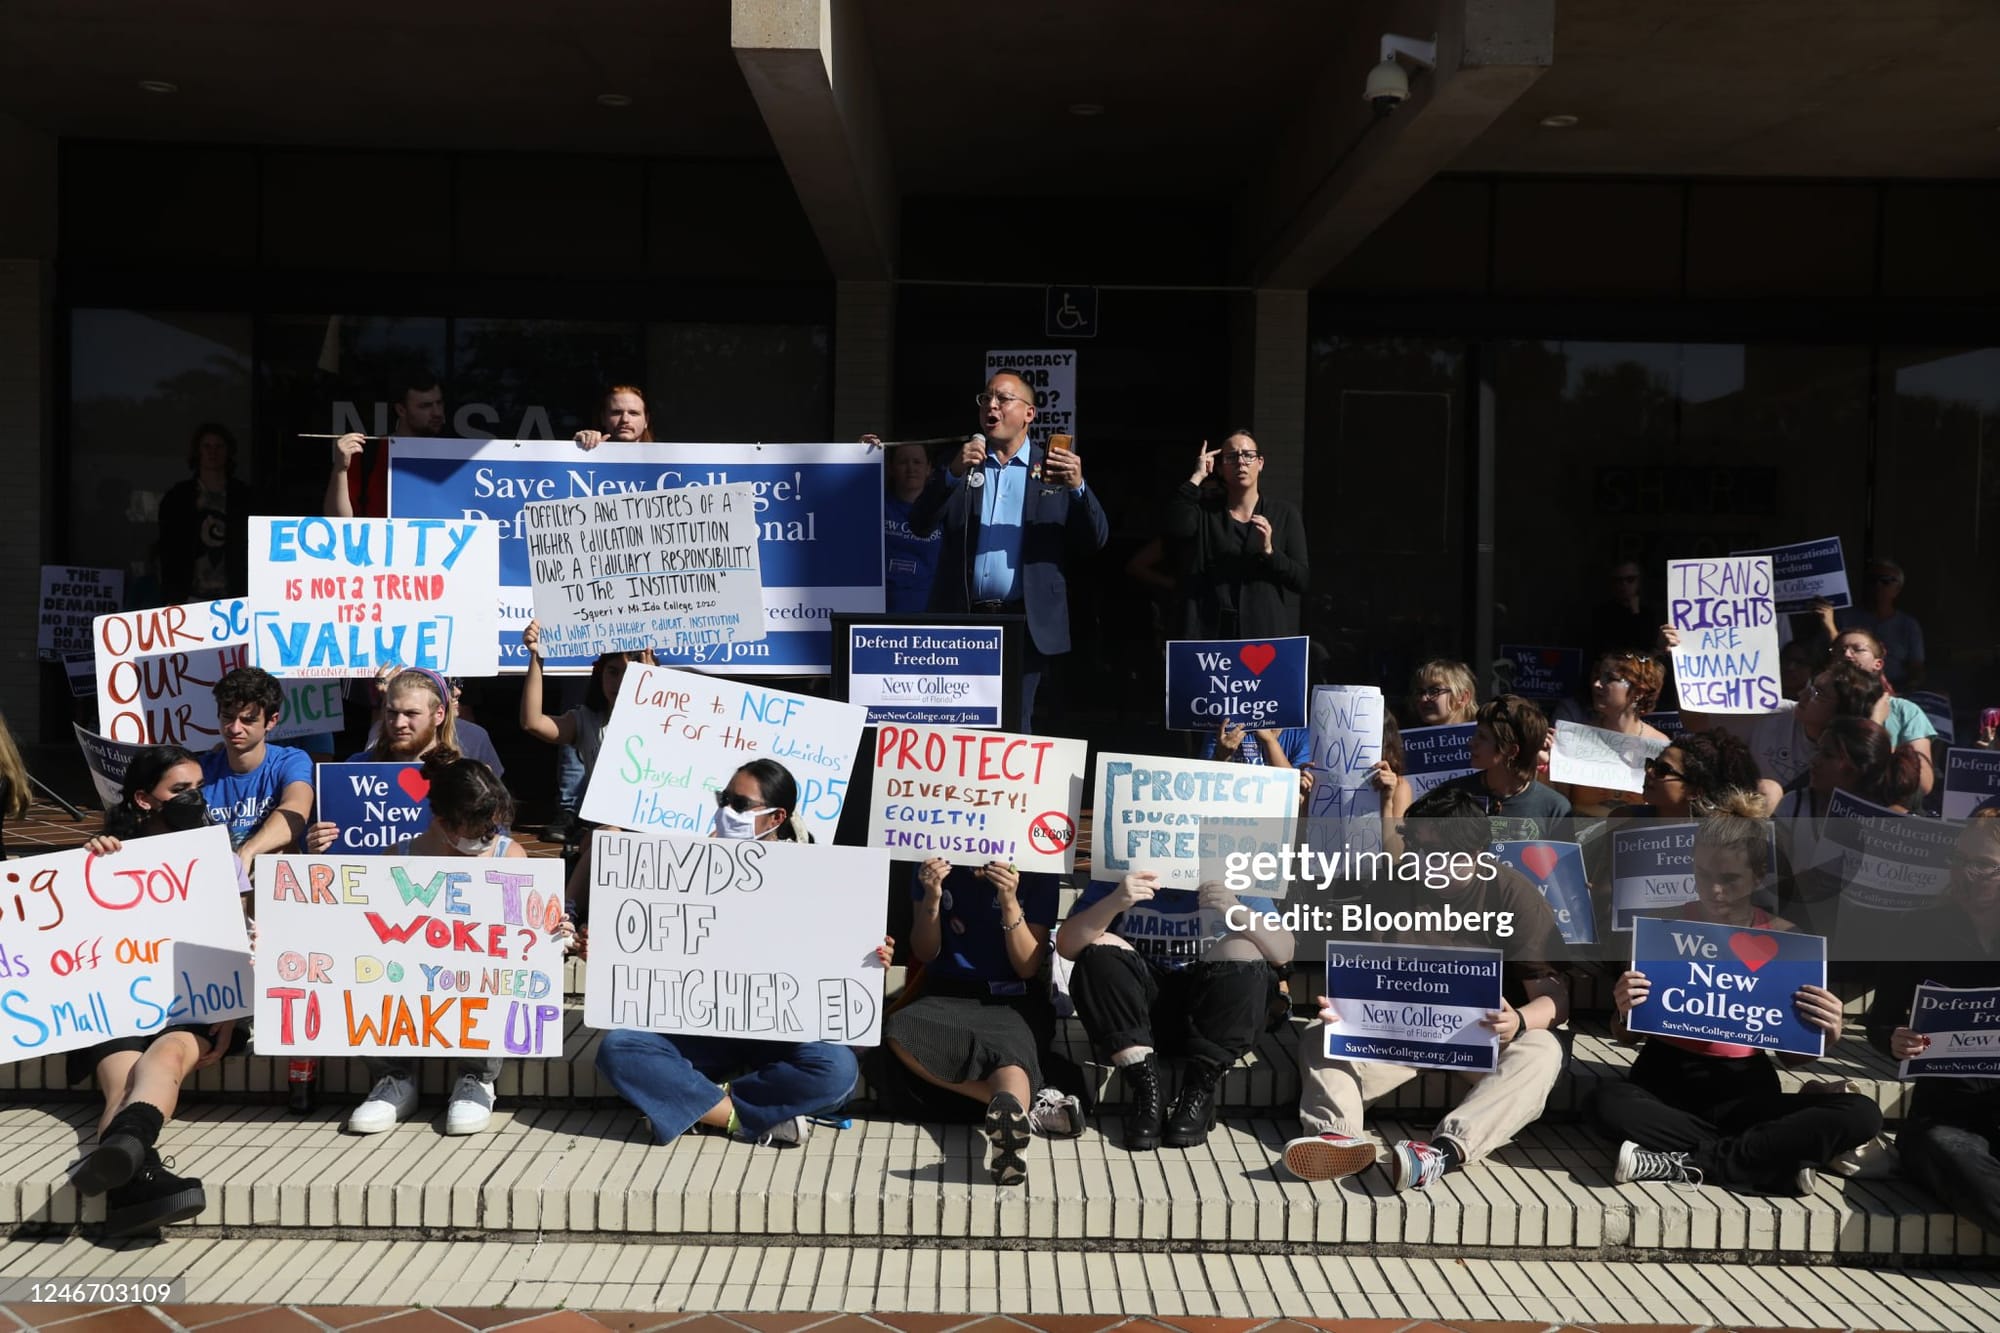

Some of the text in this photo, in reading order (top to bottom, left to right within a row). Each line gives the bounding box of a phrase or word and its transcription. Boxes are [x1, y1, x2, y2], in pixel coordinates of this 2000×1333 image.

[988, 354, 1072, 367] DEMOCRACY
[1016, 369, 1049, 387] OR
[474, 467, 801, 512] Save New Cllge!
[701, 494, 714, 513] OF
[723, 493, 732, 513] A
[650, 521, 729, 545] INSTITUTION
[66, 569, 99, 583] THE
[572, 557, 583, 580] A
[1672, 560, 1770, 598] TRANS
[1775, 562, 1813, 574] eedom
[51, 583, 113, 599] PEOPLE
[285, 578, 302, 601] IS
[311, 576, 346, 600] NOT
[374, 574, 445, 601] TREND
[561, 584, 584, 602] TO
[44, 598, 118, 612] DEMAND
[338, 603, 366, 623] IT'S
[664, 600, 693, 612] College
[696, 599, 717, 609] 2020
[765, 602, 834, 620] eedom
[1673, 597, 1773, 631] RIGHTS
[42, 614, 62, 626] NO
[53, 626, 73, 638] ON
[102, 605, 204, 656] OUR
[594, 622, 607, 638] IS
[609, 620, 616, 636] A
[689, 613, 740, 627] INSTITUTION
[675, 629, 721, 646] FACULTY
[855, 635, 999, 650] Defend Educational
[1702, 626, 1743, 650] ARE
[894, 651, 960, 666] Freedom
[1195, 652, 1232, 673] We
[1517, 651, 1538, 665] We
[1675, 651, 1760, 679] HUMAN
[107, 652, 216, 704] OUR
[1523, 664, 1553, 678] New
[882, 676, 970, 699] New College
[1209, 675, 1262, 695] New
[1512, 676, 1563, 692] College
[1681, 675, 1779, 709] RIGHTS
[634, 670, 805, 727] Came to NCF
[1190, 696, 1279, 720] College
[111, 703, 222, 745] OUR
[868, 711, 980, 723] SaveNewCollege.org/Join
[1329, 695, 1375, 733] WE
[660, 713, 711, 741] for
[720, 726, 758, 751] the
[877, 726, 1054, 784] PROTECT
[1311, 735, 1381, 774] LOVE
[1401, 736, 1436, 753] fend
[101, 758, 127, 777] Freed
[621, 735, 693, 790] Stayed
[1424, 750, 1472, 766] Freedo
[349, 775, 389, 797] We
[887, 778, 1027, 813] DIVERSITY!
[1131, 769, 1271, 804] PROTECT
[364, 801, 423, 823] New
[632, 789, 703, 833] liberal
[1311, 783, 1370, 825] PAT
[885, 805, 985, 831] EQUITY!
[1122, 810, 1259, 826] EDUCATIONAL
[344, 825, 424, 848] Colle
[885, 829, 1015, 861] INCLUSION!
[1033, 826, 1073, 841] BIGOTS
[1617, 835, 1670, 853] Defend
[1856, 828, 1930, 858] Freedom
[1880, 818, 1960, 850] Educatio
[598, 835, 767, 896] HANDS
[273, 860, 369, 905] ARE
[390, 865, 473, 916] WE
[1645, 878, 1681, 896] New
[0, 869, 64, 931] ig
[364, 911, 538, 961] WOKE?
[616, 898, 716, 955] OFF
[1125, 915, 1200, 936] MARCH
[1671, 932, 1718, 958] We
[277, 951, 551, 1000] OR DO YOU NEED
[1331, 952, 1497, 978] Defend Educational
[1687, 961, 1759, 993] New
[1376, 974, 1450, 994] Freedom
[611, 964, 876, 1042] HIGHER ED
[1661, 987, 1783, 1032] College
[1921, 996, 1996, 1011] Defend
[266, 986, 560, 1055] TO WAKE UP
[1362, 1003, 1463, 1035] New College
[1406, 1029, 1442, 1040] of Florida
[1662, 1020, 1780, 1044] SaveNewCollege.org/Join
[1949, 1033, 1995, 1048] New
[1345, 1042, 1474, 1064] SaveNewCollege.org/Join
